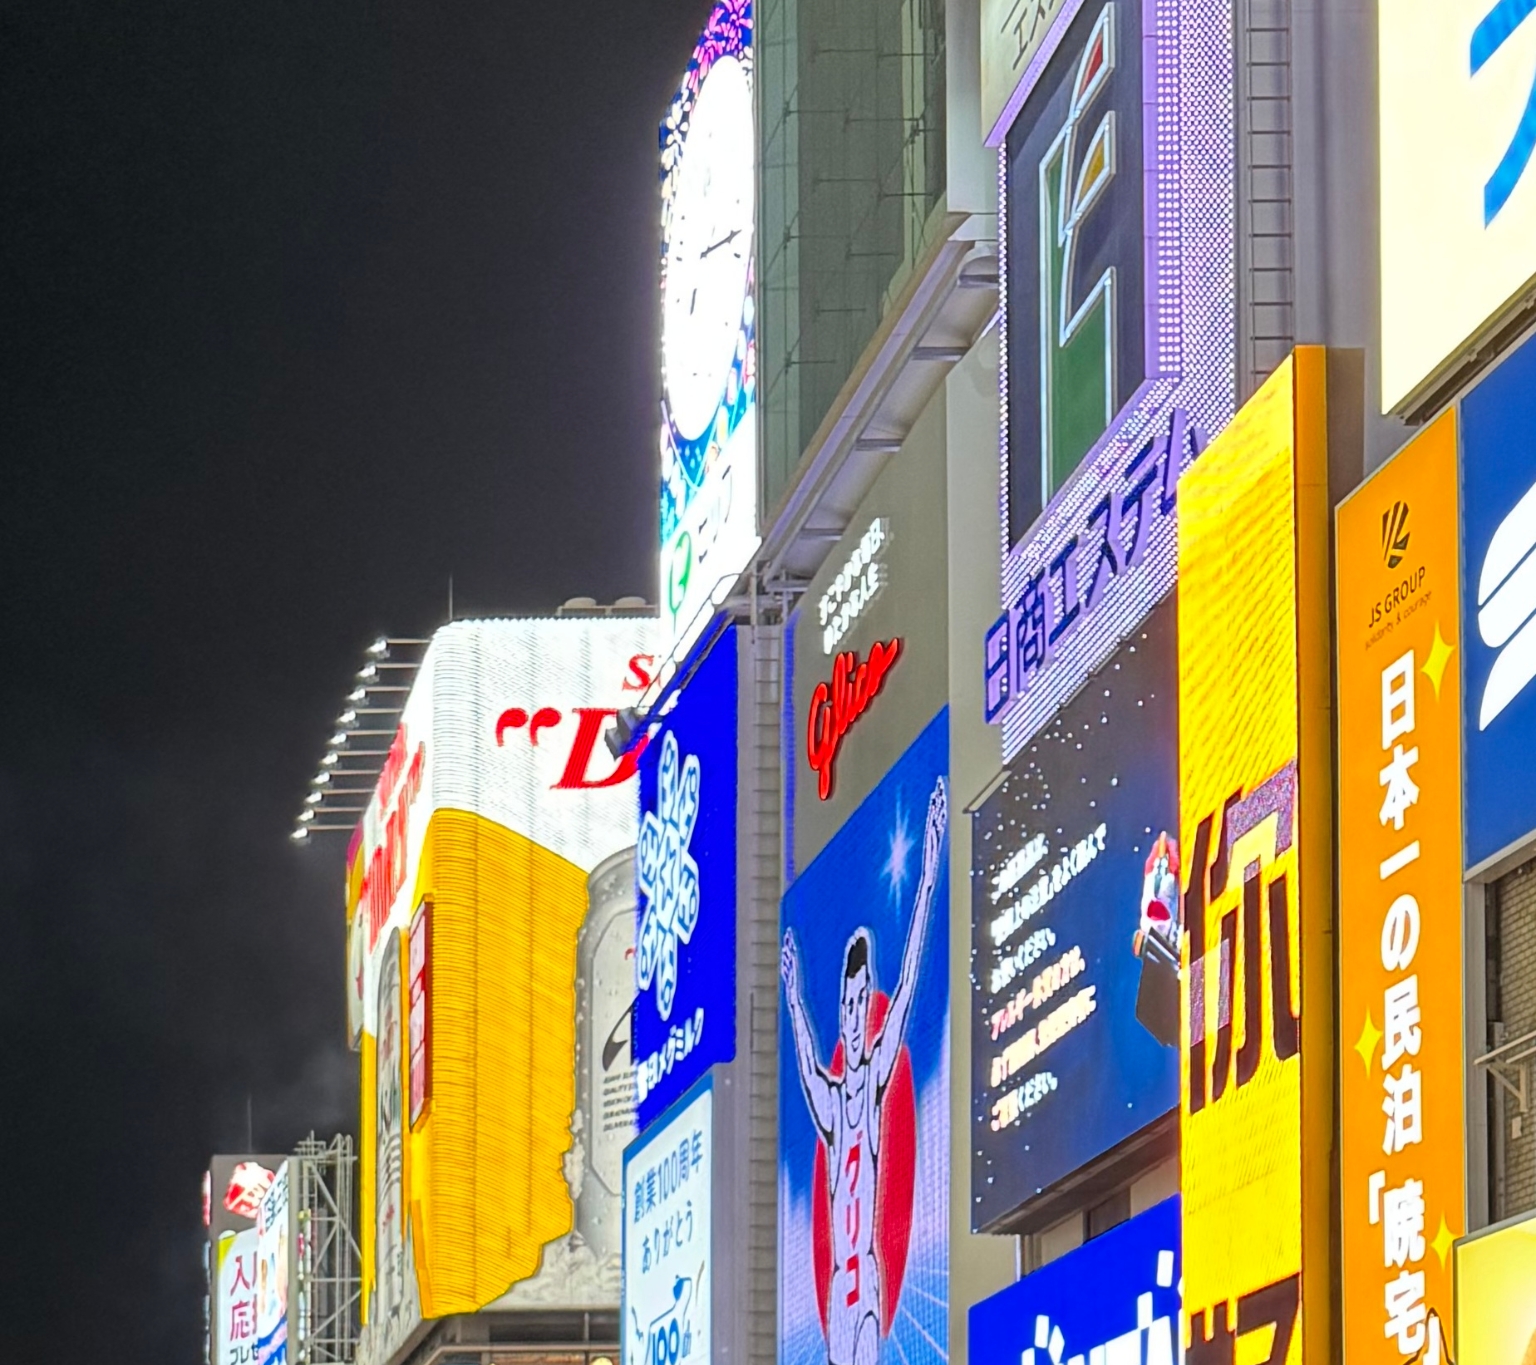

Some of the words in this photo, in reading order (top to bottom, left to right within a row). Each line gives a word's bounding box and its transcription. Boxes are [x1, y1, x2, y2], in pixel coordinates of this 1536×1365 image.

[1368, 601, 1382, 629] JS
[1383, 565, 1426, 615] GROUP
[634, 1128, 704, 1223] 創業100周年
[641, 1200, 694, 1275] ありがとう
[844, 1132, 863, 1308] グリコ
